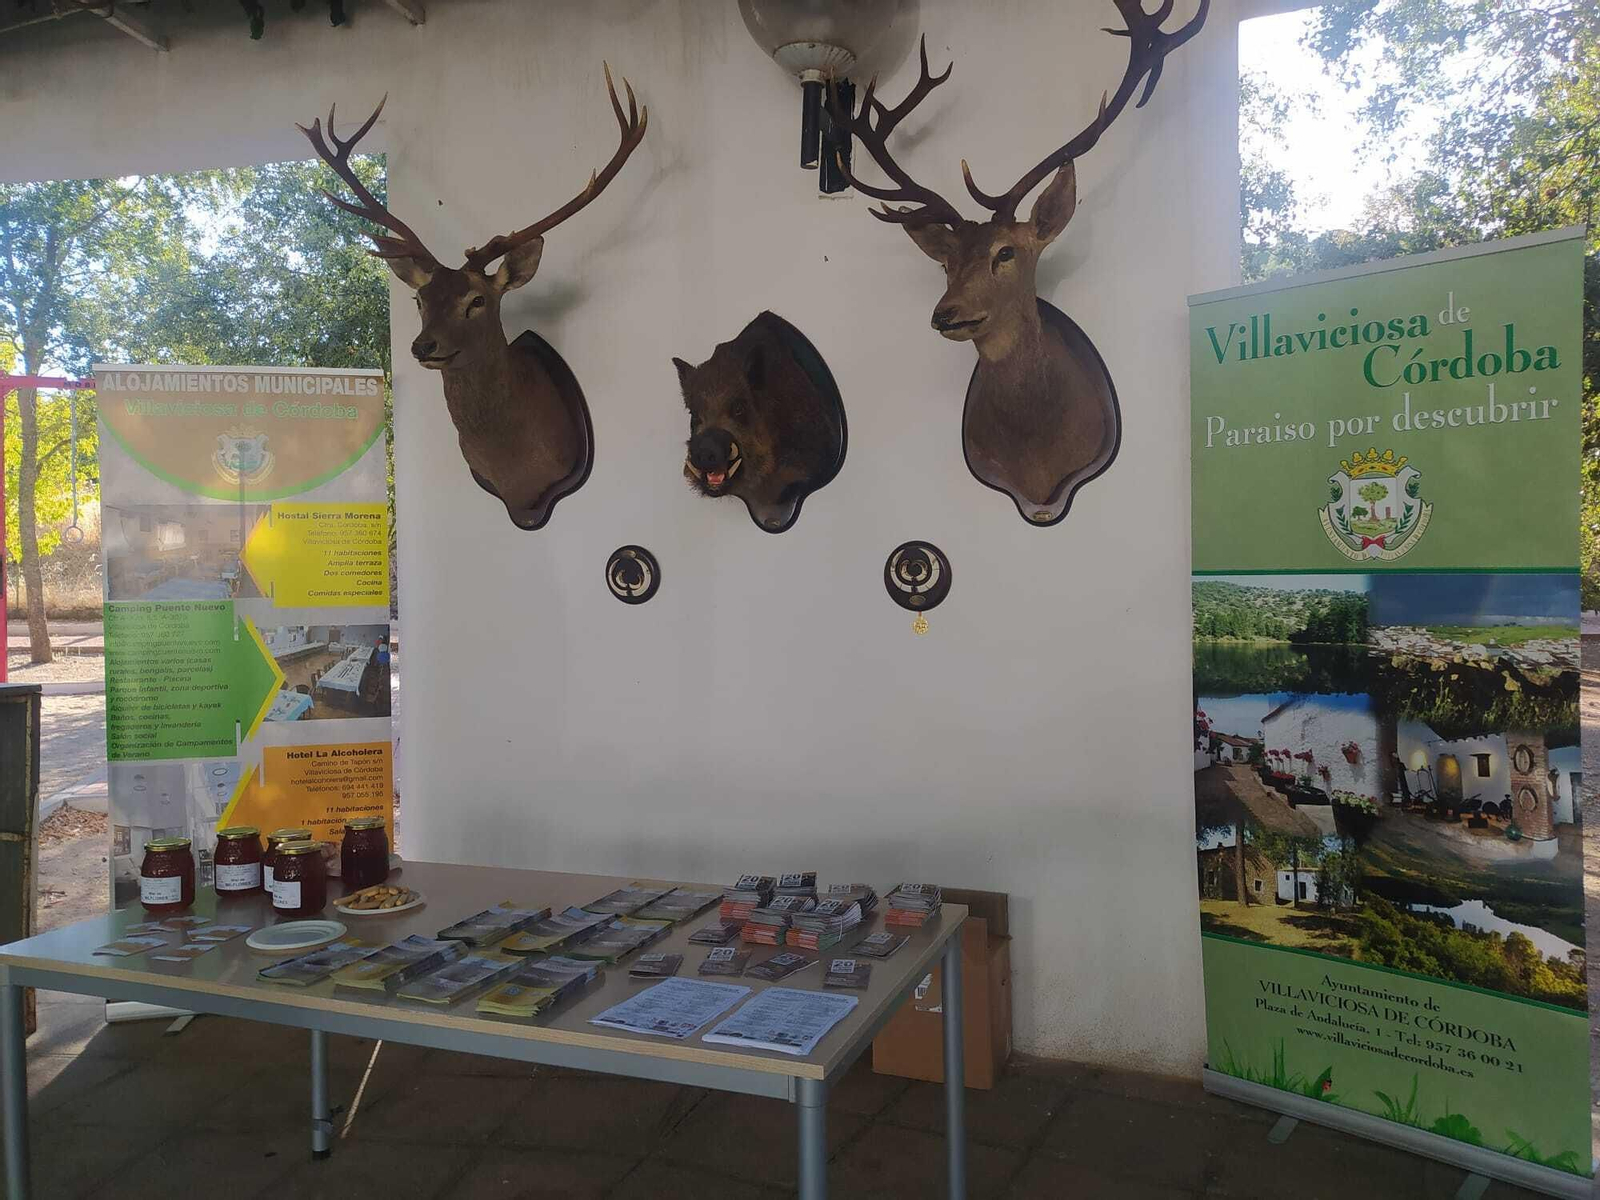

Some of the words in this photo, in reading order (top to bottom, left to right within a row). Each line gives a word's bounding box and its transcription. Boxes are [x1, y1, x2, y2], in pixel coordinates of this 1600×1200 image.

[1205, 308, 1432, 365] Villaviciosa
[1438, 292, 1471, 326] de
[1363, 323, 1561, 388] Córdoba
[102, 373, 249, 393] ALOJAMIENTOS
[254, 375, 379, 396] MUNICIPALES
[124, 398, 238, 416] Villaviciosa
[242, 400, 268, 416] de
[272, 400, 359, 419] Córdoba
[1205, 413, 1315, 449] Paraiso
[1328, 414, 1381, 448] por
[1392, 383, 1560, 433] descubrir
[277, 512, 309, 520] Hostal
[312, 512, 342, 520] Sierra
[344, 512, 382, 520] Morena
[327, 560, 354, 568] Amplia
[323, 569, 338, 577] Dos
[307, 589, 341, 597] Comidas
[108, 604, 152, 613] Camping
[154, 604, 192, 612] Puente
[194, 603, 226, 612] Nuevo
[191, 684, 229, 692] deportiva
[141, 703, 151, 711] de
[152, 703, 191, 711] bicicletas
[133, 732, 158, 740] social
[176, 739, 233, 748] Campamentos
[286, 751, 313, 760] Hotel
[315, 750, 328, 758] La
[331, 748, 383, 757] Alcoholera
[304, 768, 341, 776] Villaviciosa
[335, 804, 384, 813] habitaciones
[1321, 975, 1419, 1007] Ayuntamiento
[1423, 997, 1440, 1012] de
[1259, 980, 1379, 1018] VILLAVICIOSA
[1384, 1007, 1410, 1026] DE
[1414, 1015, 1517, 1052] CÓRDOBA
[1254, 997, 1287, 1014] Plaza
[1290, 1005, 1303, 1018] de
[1395, 1029, 1421, 1047] Tel:
[1425, 1039, 1452, 1054] 957
[1457, 1047, 1476, 1061] 36
[1480, 1054, 1500, 1067] 00
[1504, 1060, 1524, 1074] 21
[1296, 1027, 1475, 1078] www.villaviciosadecordoba.es
